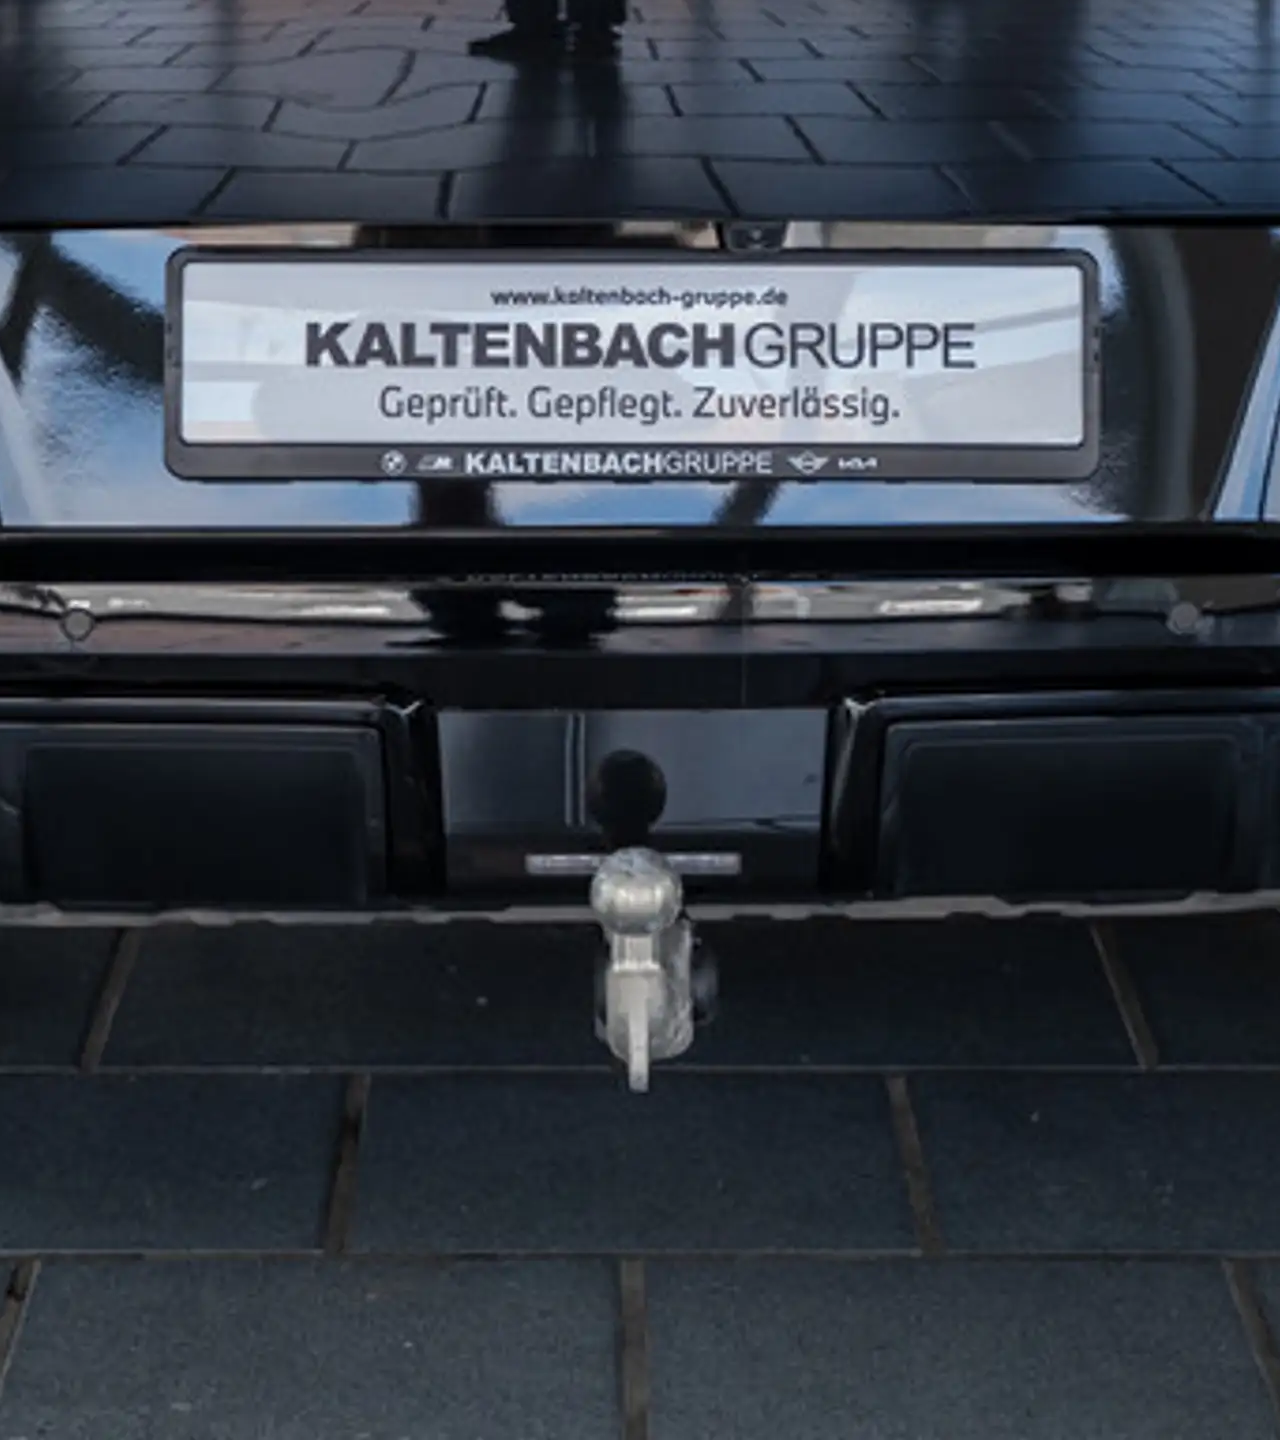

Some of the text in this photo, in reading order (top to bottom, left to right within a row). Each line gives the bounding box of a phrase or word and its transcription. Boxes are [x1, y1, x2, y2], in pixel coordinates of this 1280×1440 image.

[489, 287, 789, 309] www.kaltenbach-gruppe.de
[378, 385, 901, 426] Geprüft. Gepflegt. Zuverlässig.
